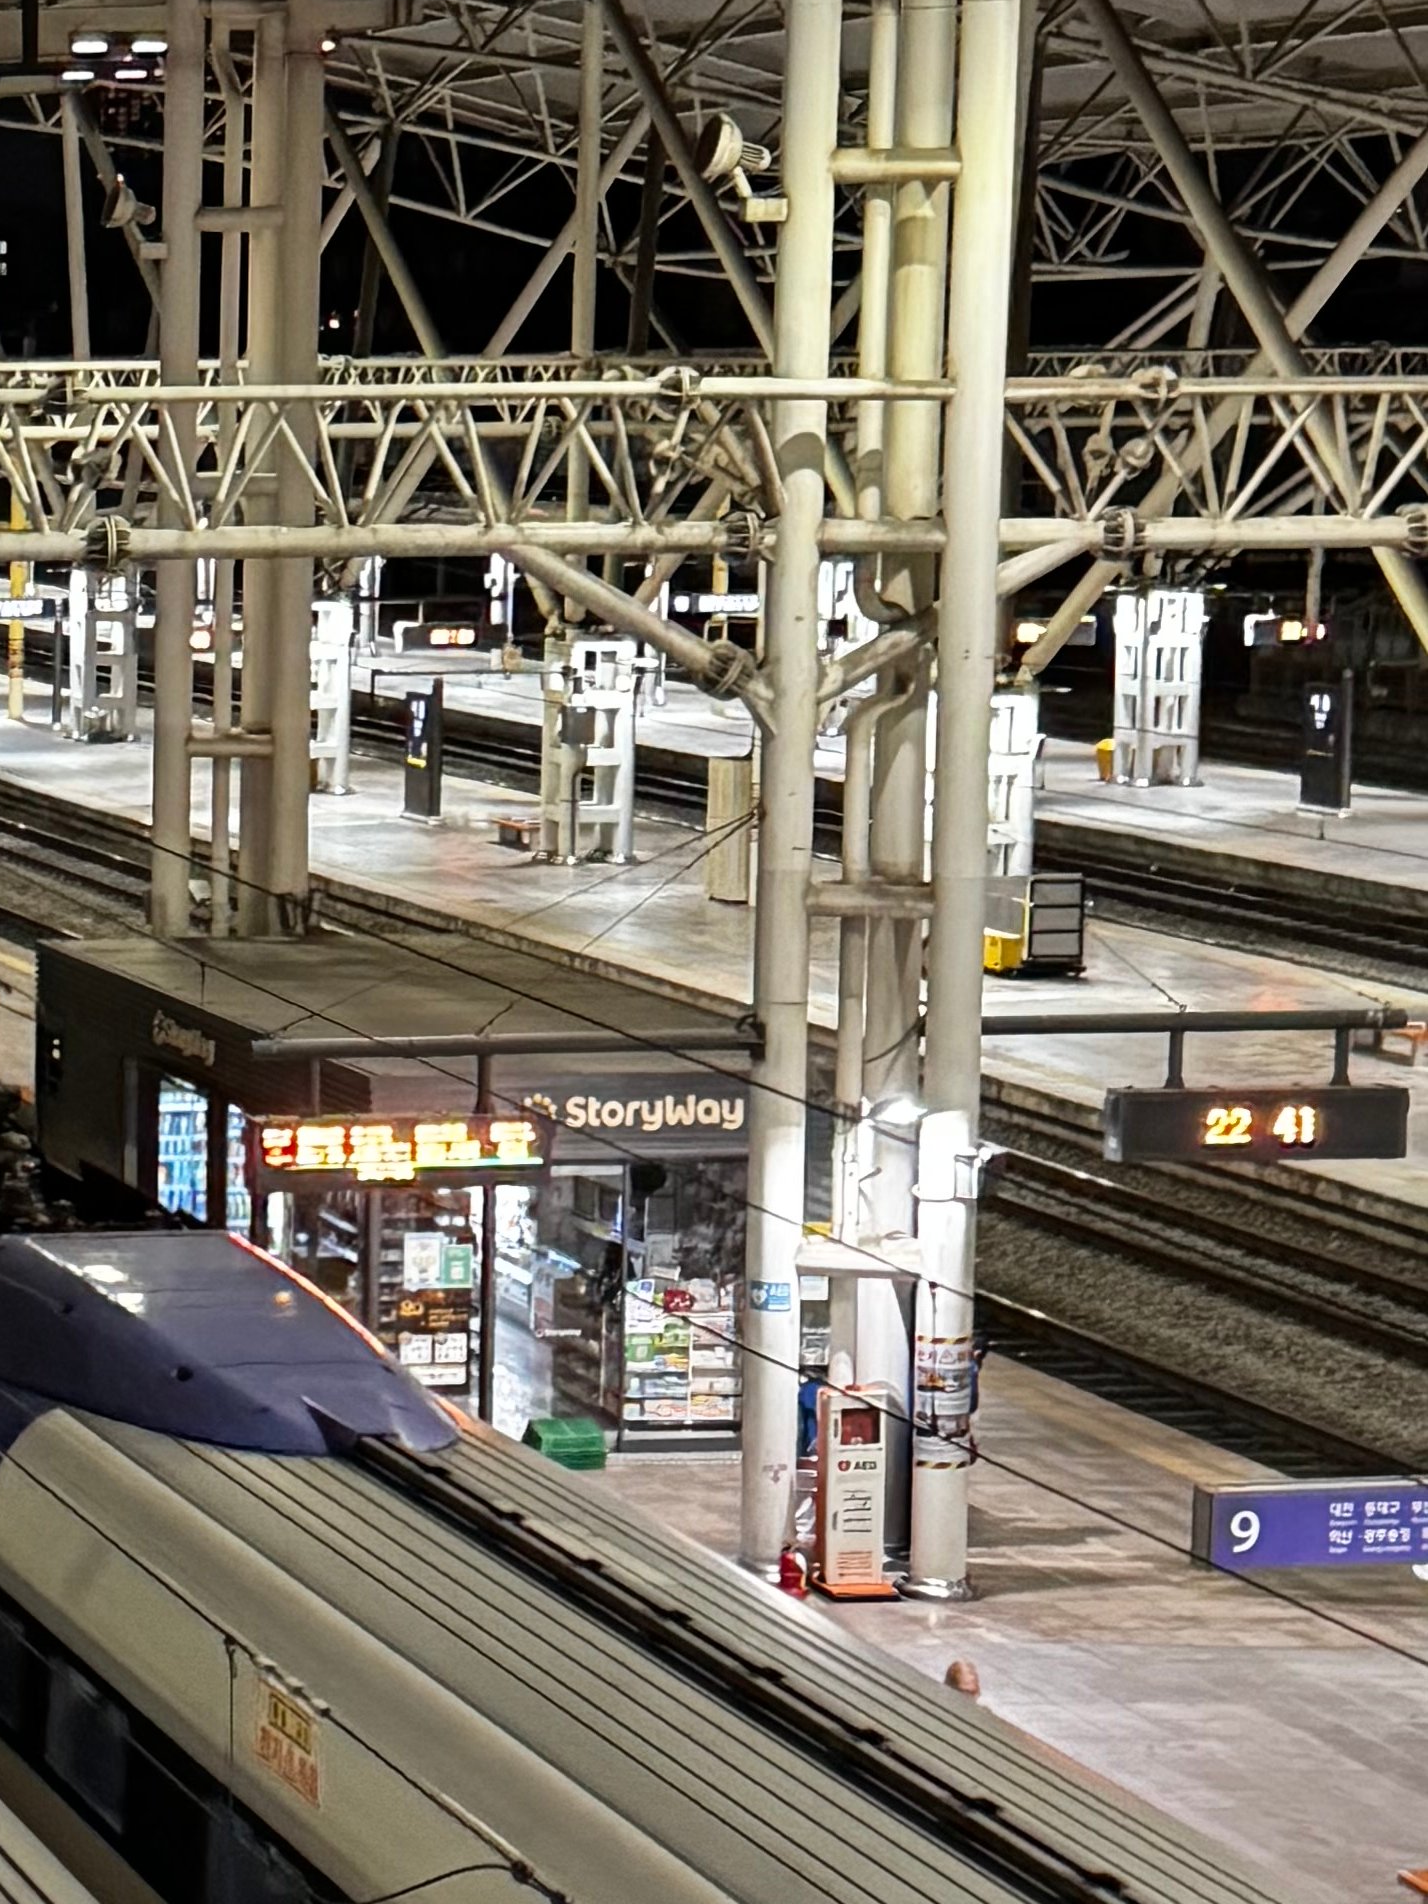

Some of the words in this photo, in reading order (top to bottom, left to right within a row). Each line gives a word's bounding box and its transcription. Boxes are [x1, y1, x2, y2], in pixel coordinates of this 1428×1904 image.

[565, 1094, 744, 1132] StoryWay
[1204, 1106, 1253, 1146] 22
[1272, 1105, 1316, 1146] 41
[1230, 1510, 1261, 1553] 9
